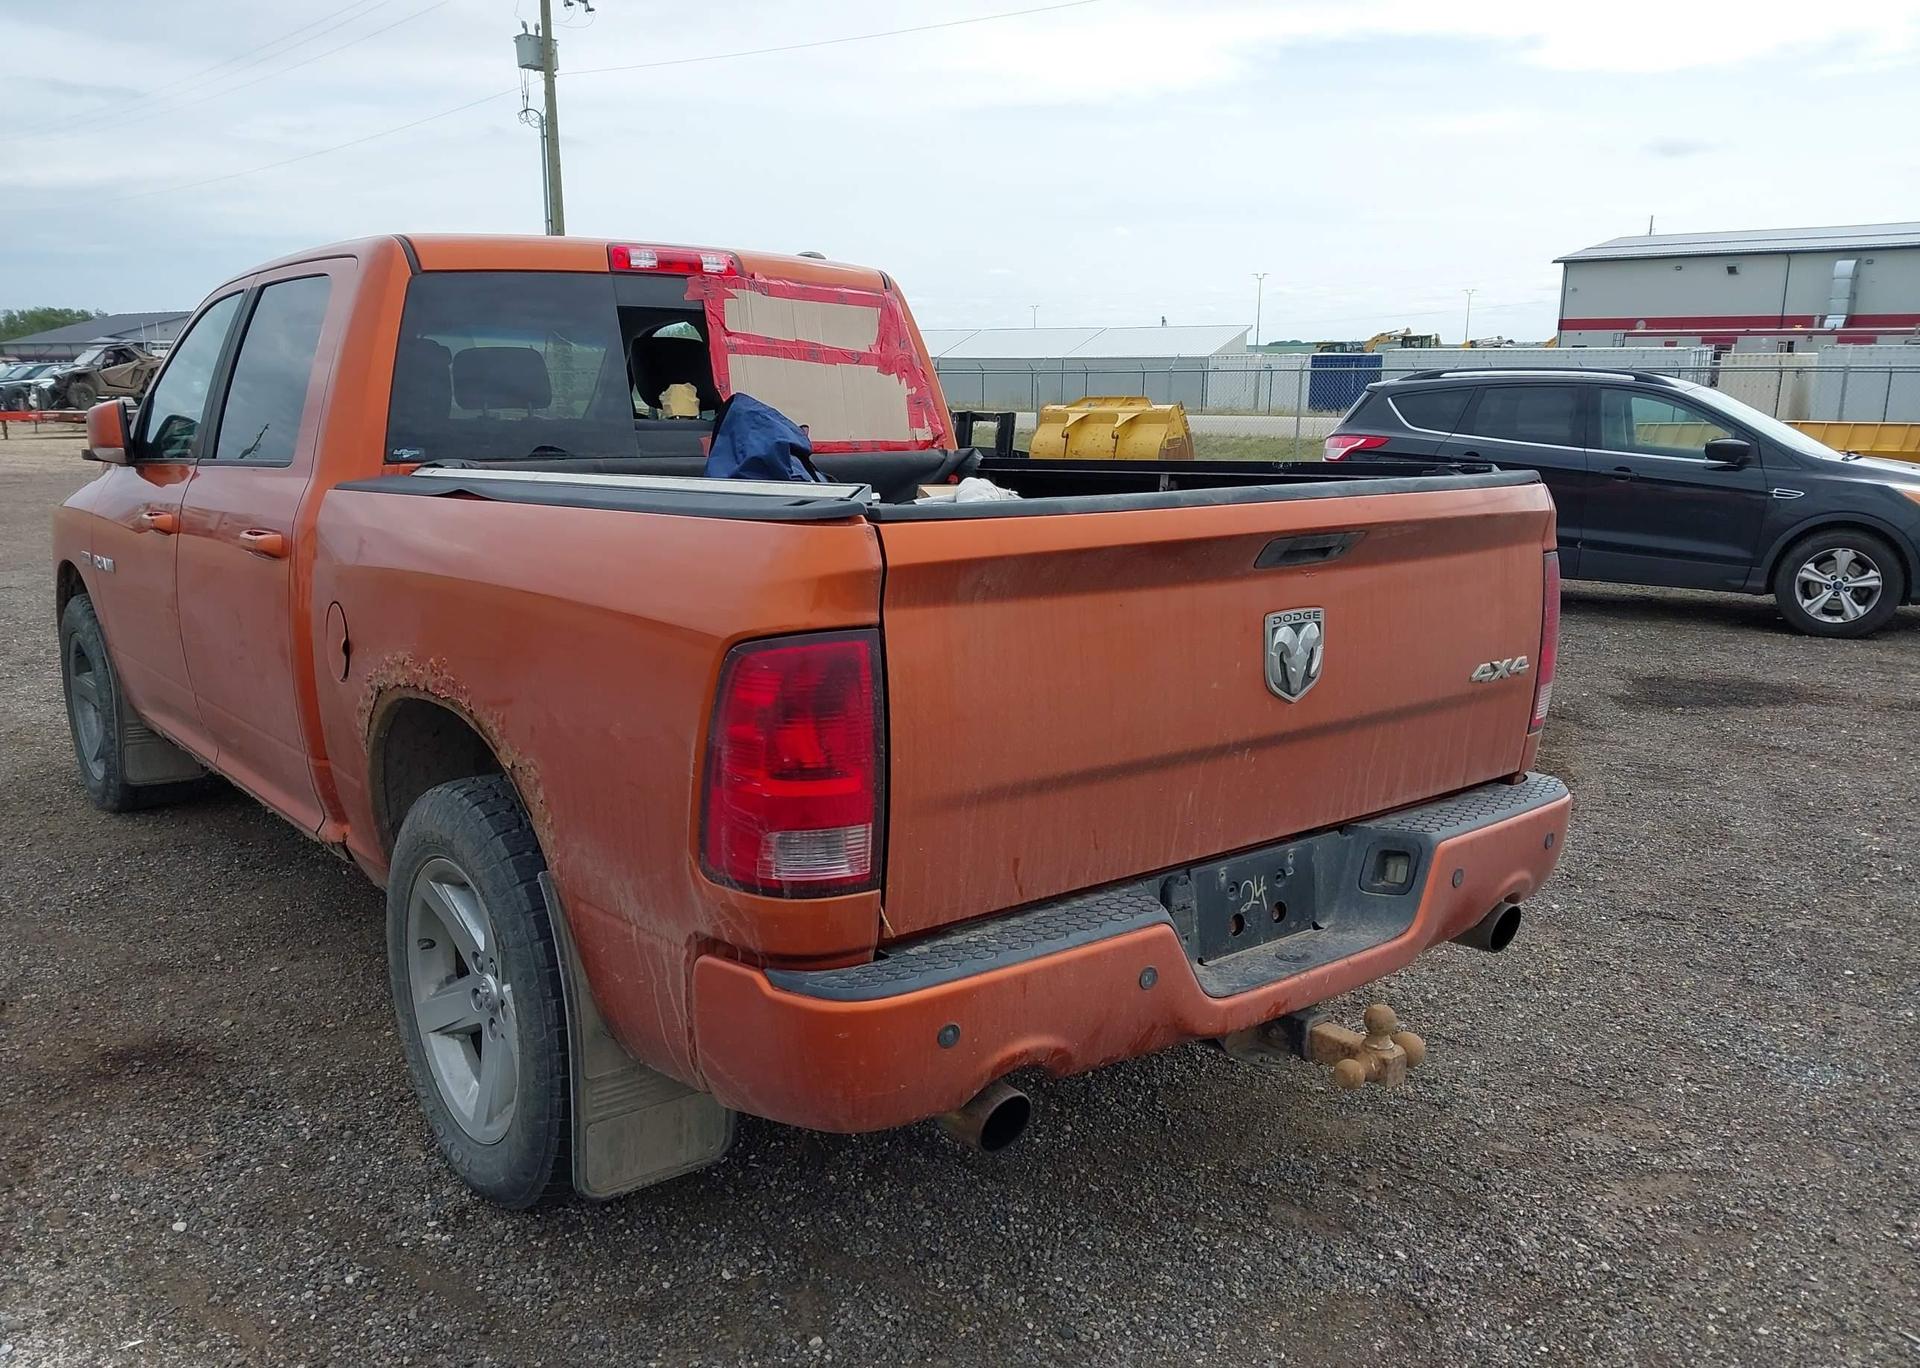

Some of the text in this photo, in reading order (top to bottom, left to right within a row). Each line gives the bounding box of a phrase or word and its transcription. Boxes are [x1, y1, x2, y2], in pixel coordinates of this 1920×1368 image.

[1273, 611, 1321, 625] DODGE
[1470, 655, 1530, 682] 4X4
[1240, 875, 1268, 913] 24
